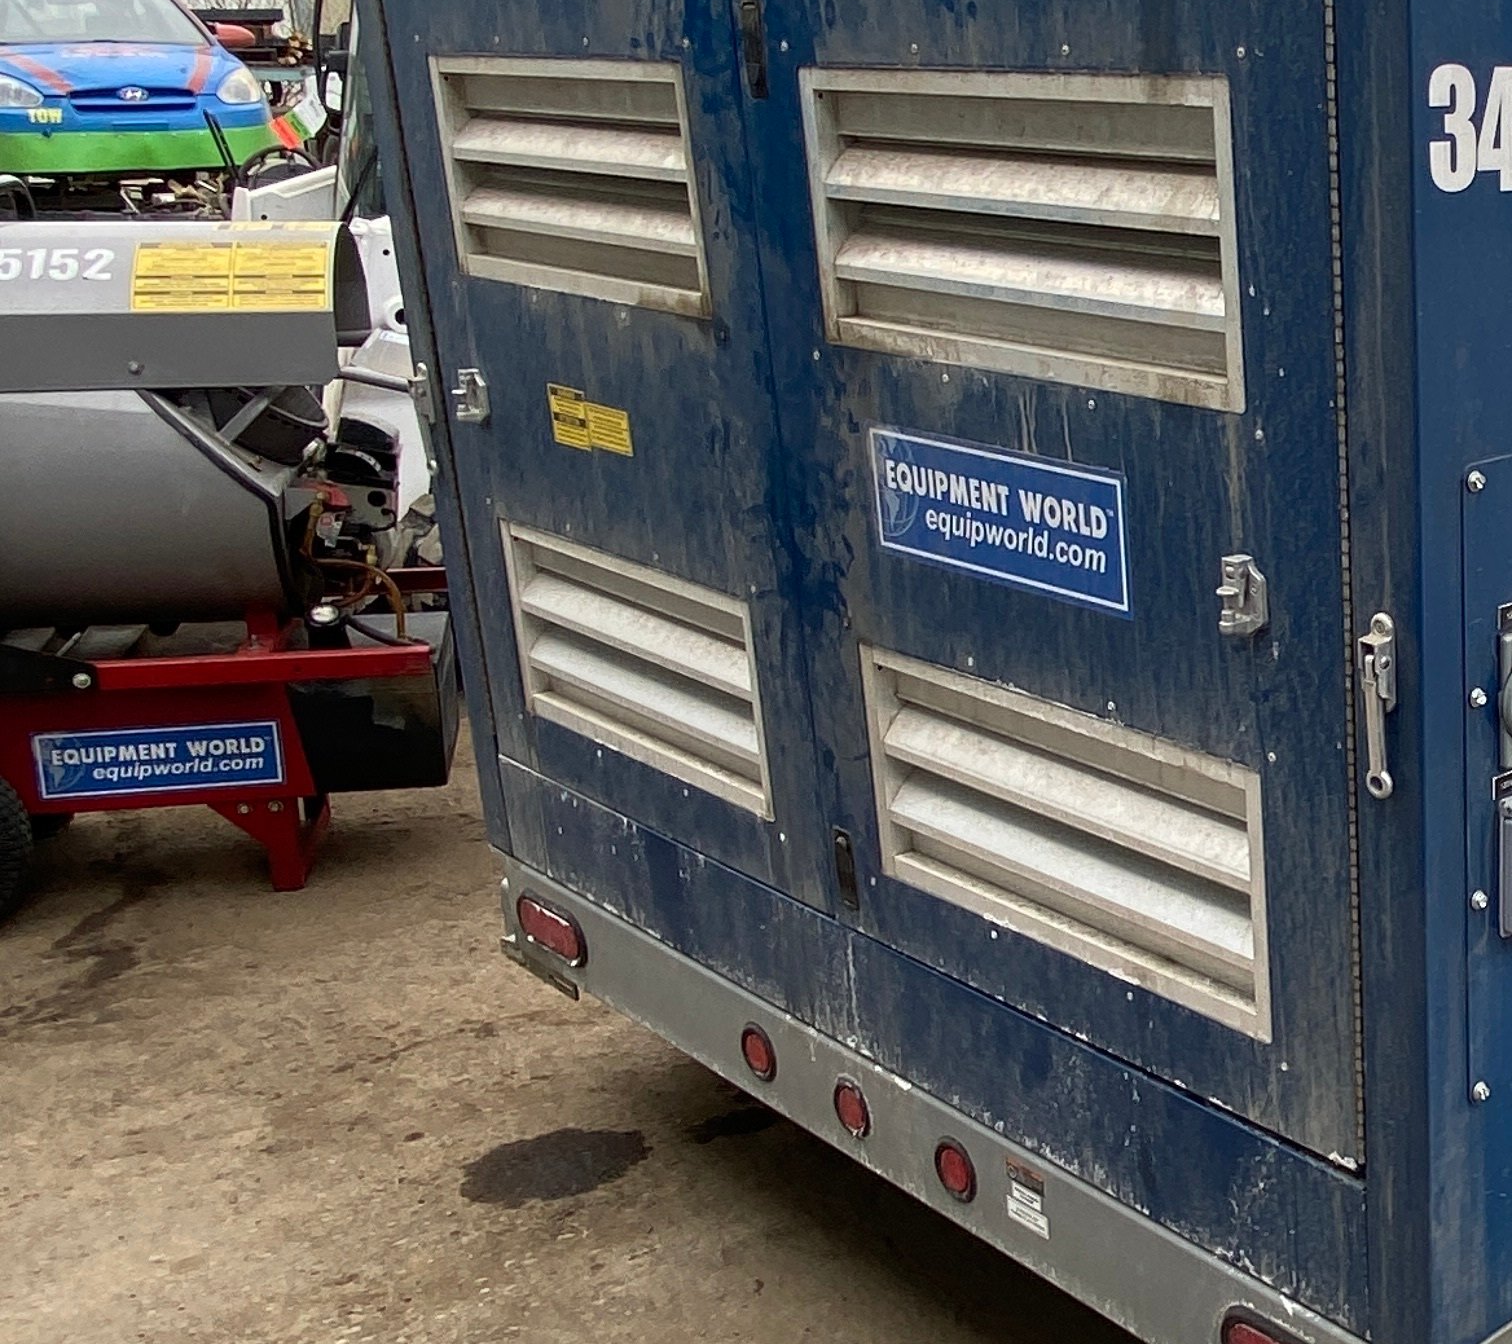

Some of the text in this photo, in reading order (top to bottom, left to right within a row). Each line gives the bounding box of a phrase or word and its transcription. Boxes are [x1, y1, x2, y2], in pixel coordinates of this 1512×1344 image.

[28, 108, 63, 124] TOW
[884, 458, 1109, 541] EQUIPMENT WORLD
[924, 508, 1107, 574] equipworld.com
[51, 735, 266, 767] EQUIPMENT WORLD
[92, 755, 265, 783] equipworld.com
